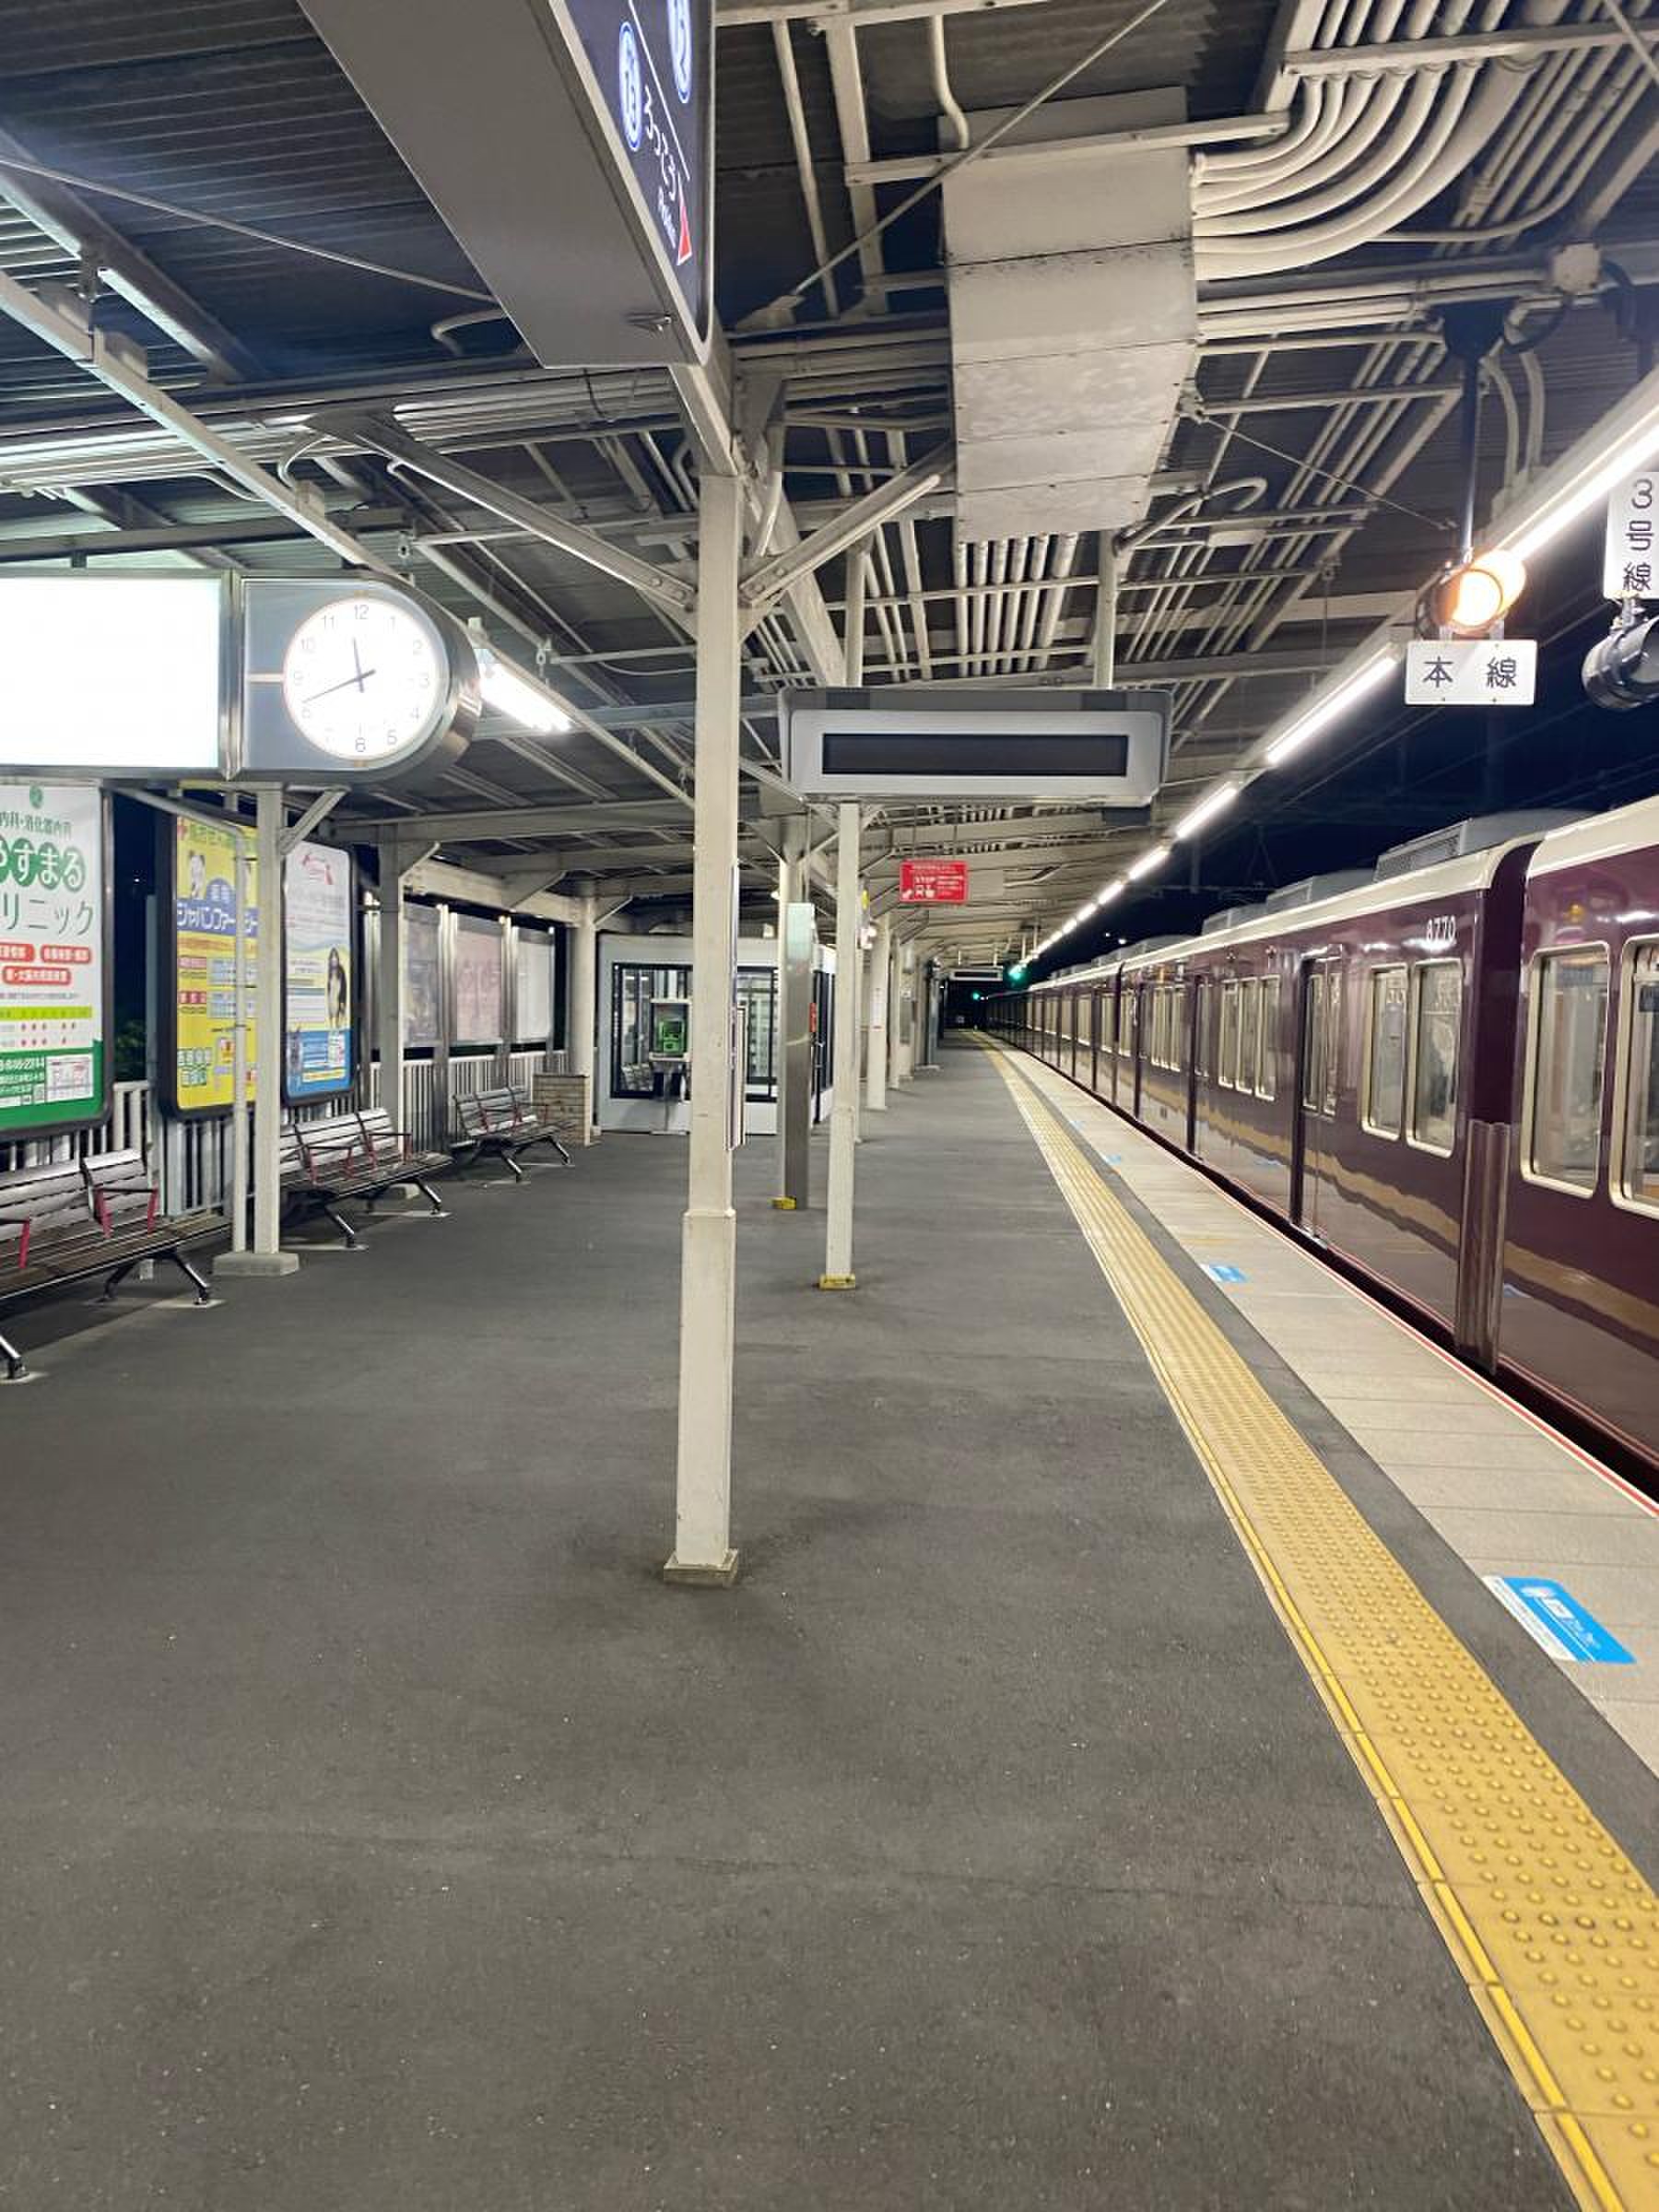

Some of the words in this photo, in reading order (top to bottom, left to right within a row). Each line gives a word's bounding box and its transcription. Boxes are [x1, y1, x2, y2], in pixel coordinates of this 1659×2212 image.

[1622, 478, 1655, 592] 3号線
[354, 604, 370, 620] 12
[1425, 914, 1456, 942] 8770
